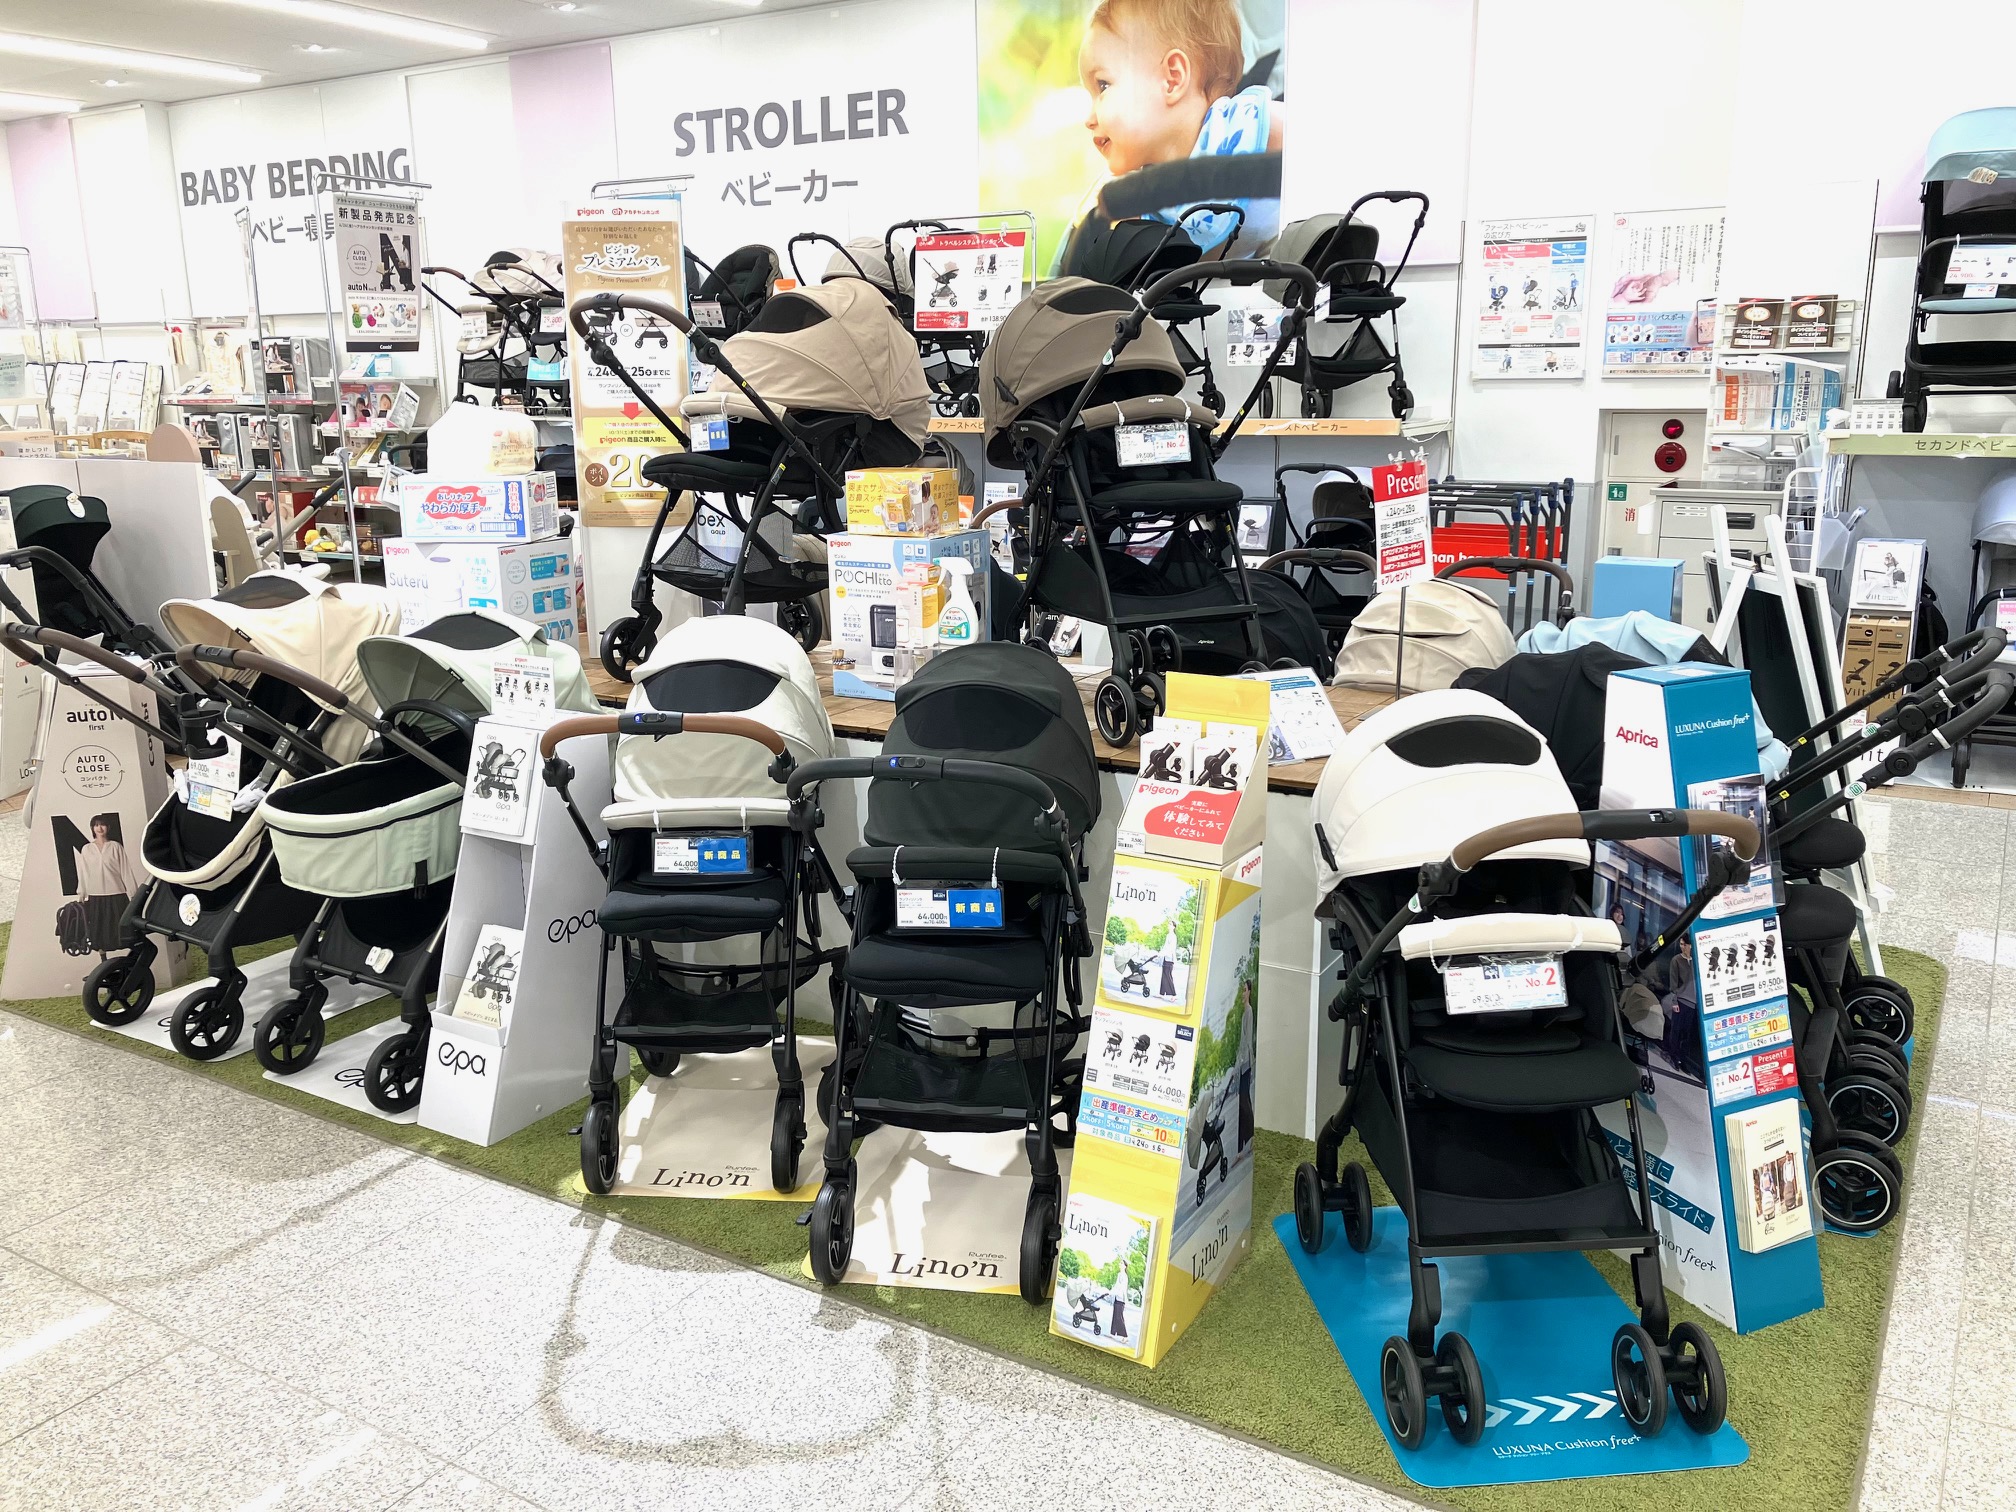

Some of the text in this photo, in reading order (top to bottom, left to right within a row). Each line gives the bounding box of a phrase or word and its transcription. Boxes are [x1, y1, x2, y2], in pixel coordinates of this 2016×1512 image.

[674, 88, 909, 157] STROLLER
[181, 147, 411, 207] BABY BEDDING
[721, 168, 859, 207] ベビーカー
[338, 207, 416, 226] 新製品発売記念
[577, 208, 604, 216] pigeon
[605, 245, 638, 254] ピジョン
[583, 254, 660, 269] プレミアムパス
[600, 436, 626, 444] pigeon
[1178, 434, 1186, 447] 2
[421, 502, 480, 514] やわらか厚手
[1625, 508, 1636, 522] 消
[386, 546, 409, 555] pigeon
[1845, 687, 1866, 697] Viit
[1674, 721, 1706, 735] LUXUNA
[1706, 717, 1733, 729] Cushion
[1615, 726, 1659, 749] Aprica
[77, 754, 106, 764] AUTO
[76, 763, 111, 773] CLOSE
[80, 774, 108, 782] コンパクト
[1138, 782, 1179, 796] pigeon
[495, 802, 511, 811] epa
[1174, 804, 1222, 816] ベビーカーにふれて
[1163, 810, 1225, 830] 体験してみて
[1173, 827, 1205, 838] ください
[704, 850, 741, 860] 新商品
[1241, 855, 1262, 877] pigeon
[1116, 882, 1157, 902] Lino'n
[955, 902, 995, 913] 新商品
[548, 909, 599, 944] epa
[1544, 967, 1556, 986] 2
[1758, 976, 1785, 990] 69,500円
[487, 1002, 502, 1012] epa
[1767, 1019, 1778, 1032] 10
[438, 1042, 487, 1076] epa
[1728, 1074, 1742, 1083] No.
[1741, 1062, 1751, 1080] 2
[1152, 1083, 1186, 1098] 64,000円
[1154, 1128, 1167, 1142] 10
[648, 1168, 752, 1188] Lino'n
[1623, 1167, 1710, 1232] 軽スライド。
[1069, 1213, 1108, 1238] Lino'n
[1191, 1224, 1229, 1285] Lino'n
[891, 1253, 1001, 1279] Lino'n
[1492, 1442, 1554, 1457] LUXUNA
[1554, 1438, 1609, 1451] Cushion
